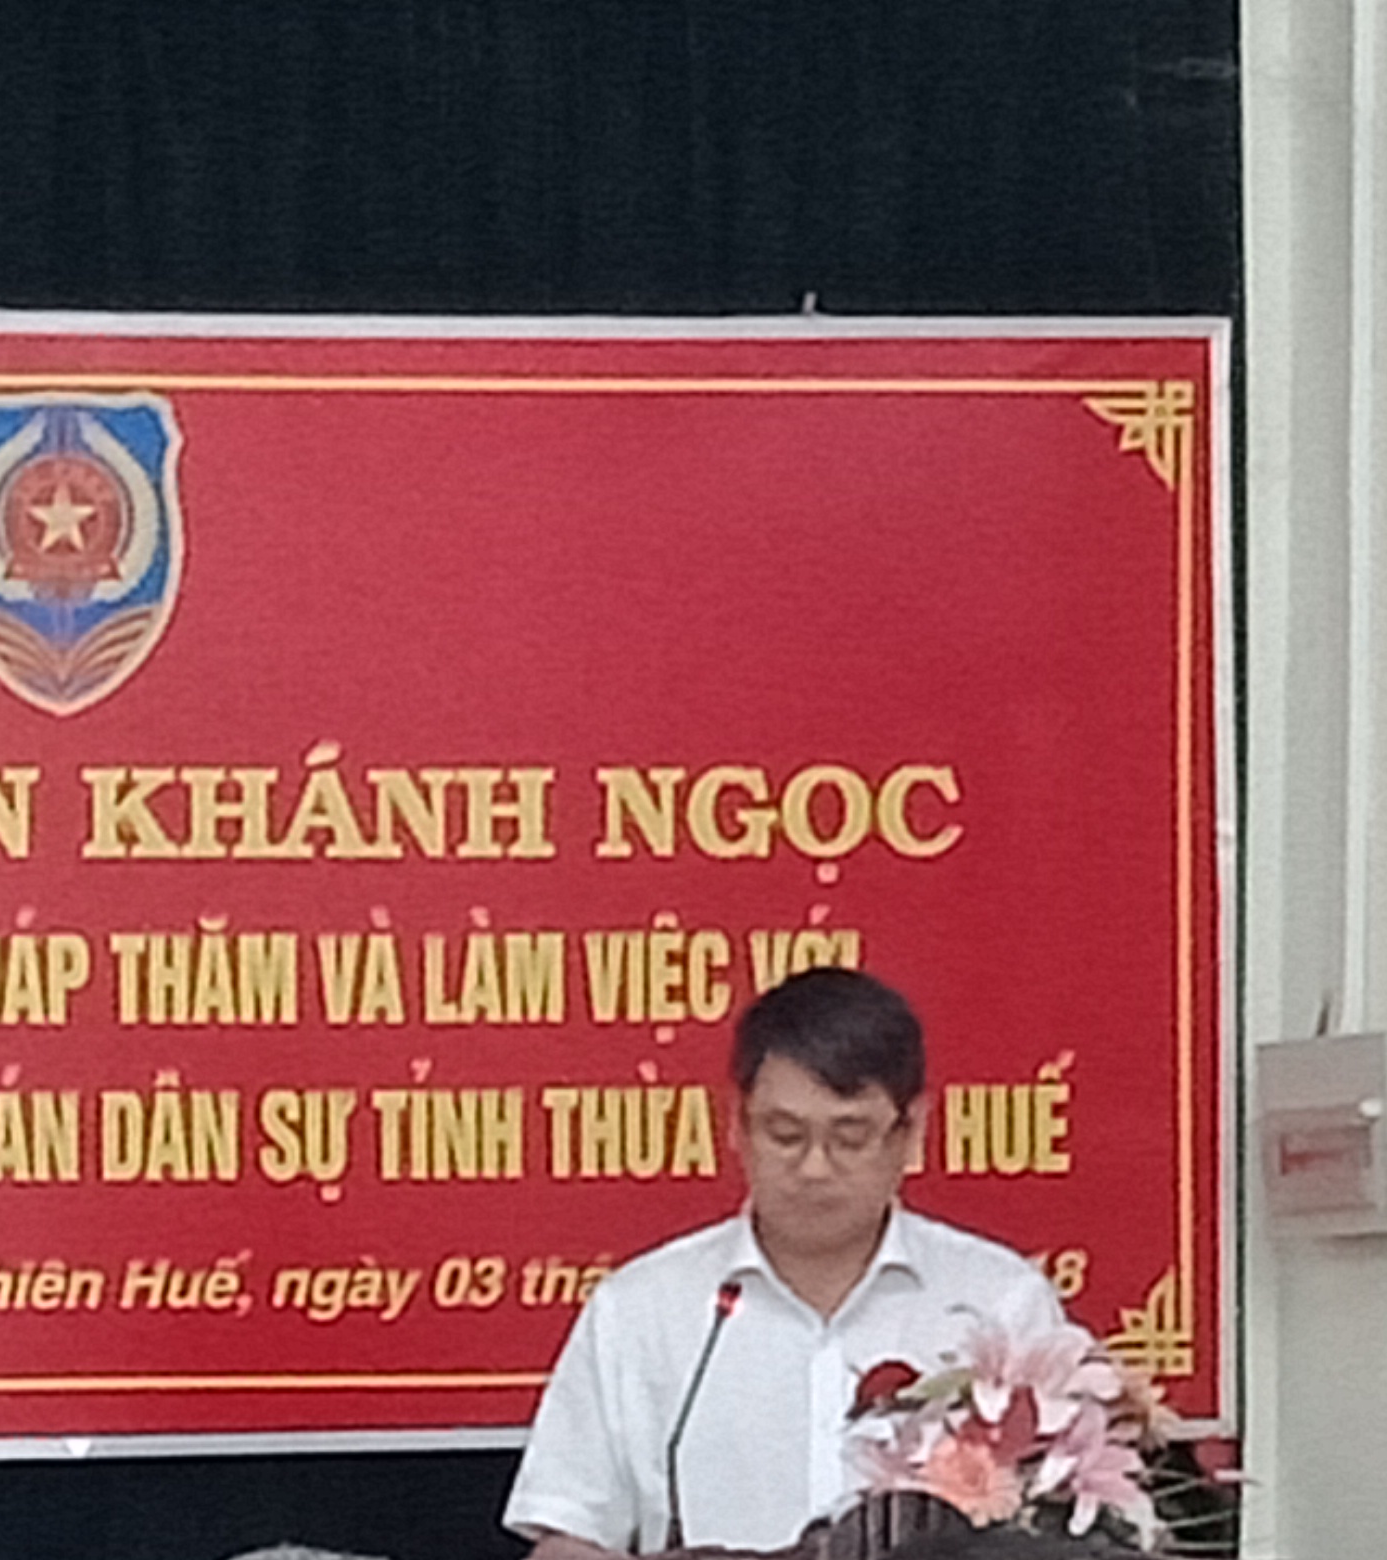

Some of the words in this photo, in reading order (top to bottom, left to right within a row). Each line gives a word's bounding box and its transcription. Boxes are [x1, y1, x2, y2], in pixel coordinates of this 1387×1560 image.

[79, 740, 558, 861] KHÁNH
[593, 763, 965, 882] NGỌC
[109, 914, 299, 1026] THĂM
[316, 906, 406, 1025] VÀ
[423, 906, 566, 1025] LÀM
[582, 911, 733, 1044] VIỆC
[100, 1068, 241, 1183] DÂN
[258, 1087, 359, 1202] SỰ
[370, 1057, 525, 1182] TỈNH
[540, 1060, 717, 1180] THỪA
[943, 1049, 1076, 1176] HUẾ
[271, 1254, 424, 1322] ngày
[433, 1255, 507, 1308] 03
